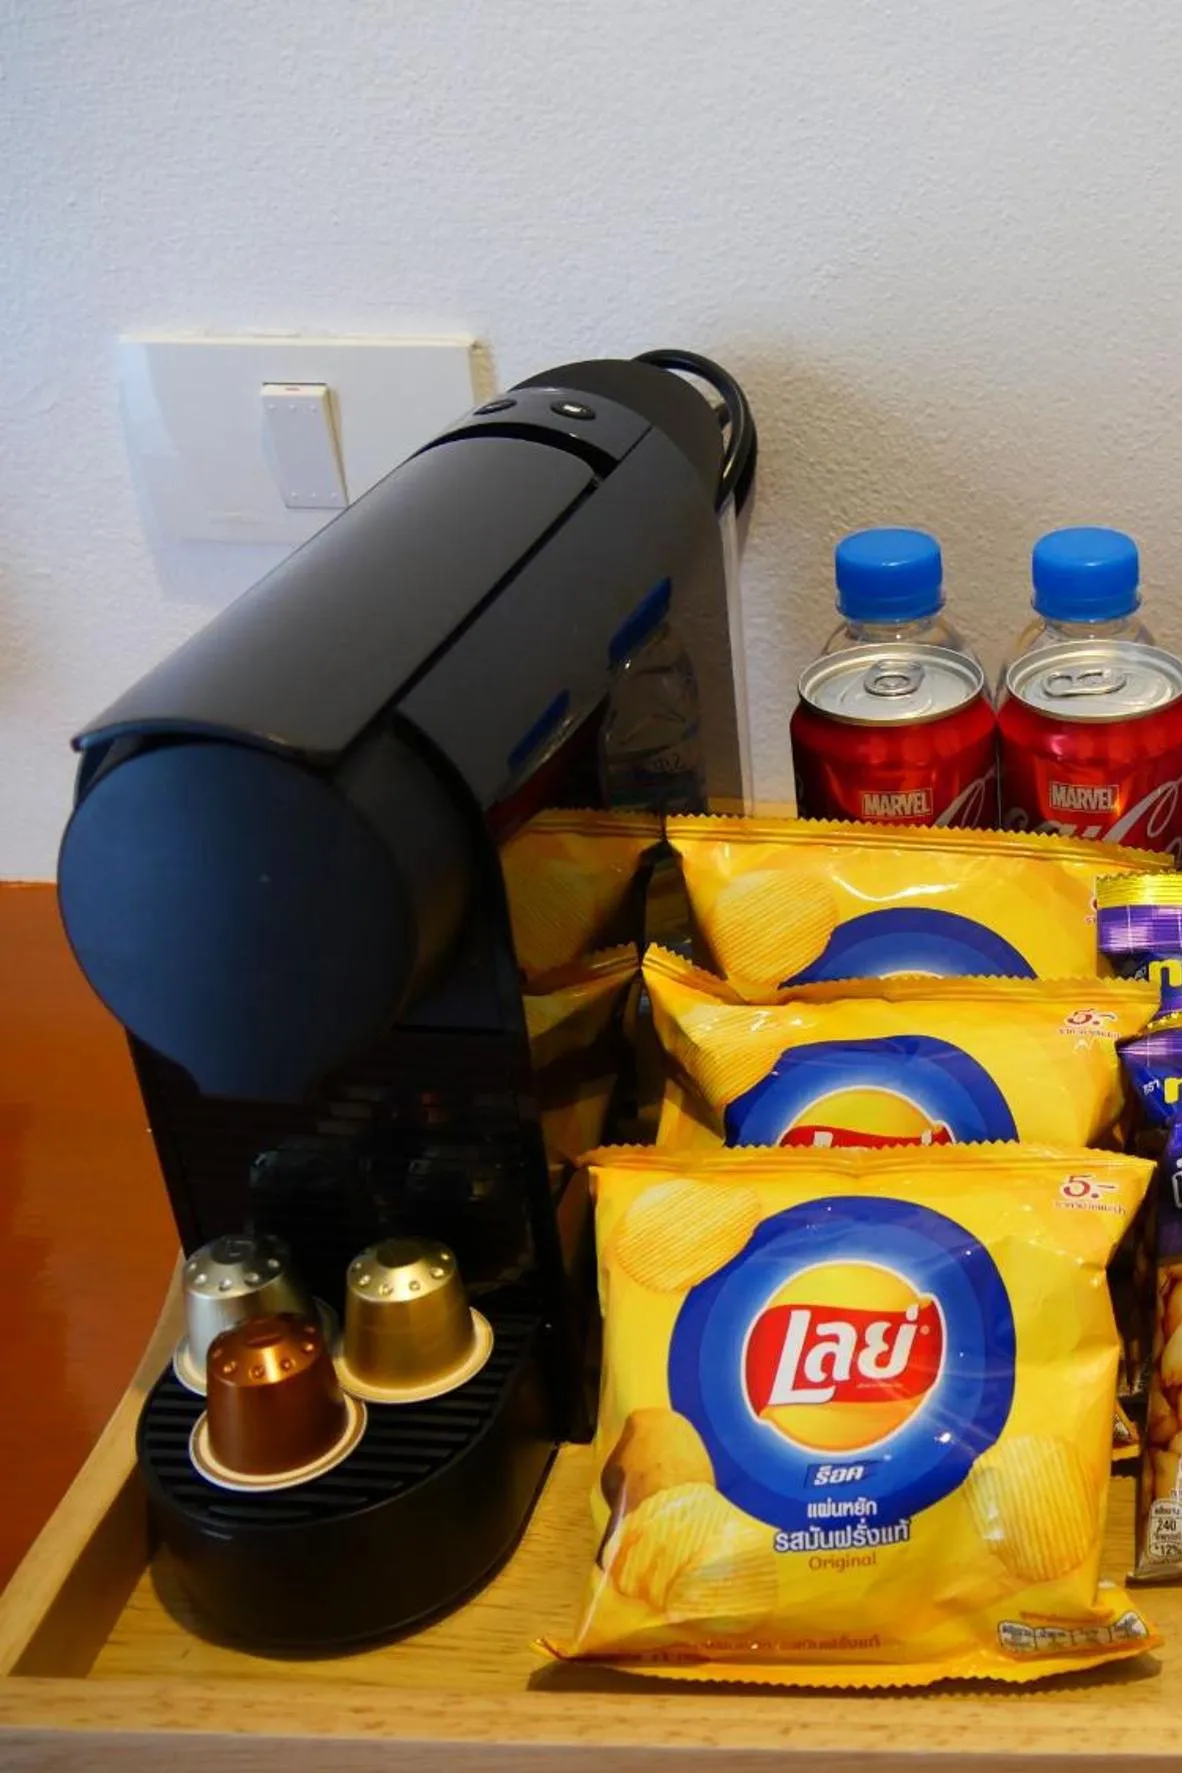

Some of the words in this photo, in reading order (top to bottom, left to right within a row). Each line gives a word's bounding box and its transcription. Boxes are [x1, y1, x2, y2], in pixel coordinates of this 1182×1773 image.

[863, 790, 932, 818] MARVEL
[1051, 784, 1118, 811] MARVEL
[768, 1304, 921, 1405] เลย์
[814, 1465, 864, 1486] ร็อค
[807, 1497, 878, 1519] แผ่นหยัก
[775, 1518, 910, 1551] รสมันฝรั่งแท้
[1156, 1519, 1177, 1532] 240
[808, 1552, 877, 1573] Original
